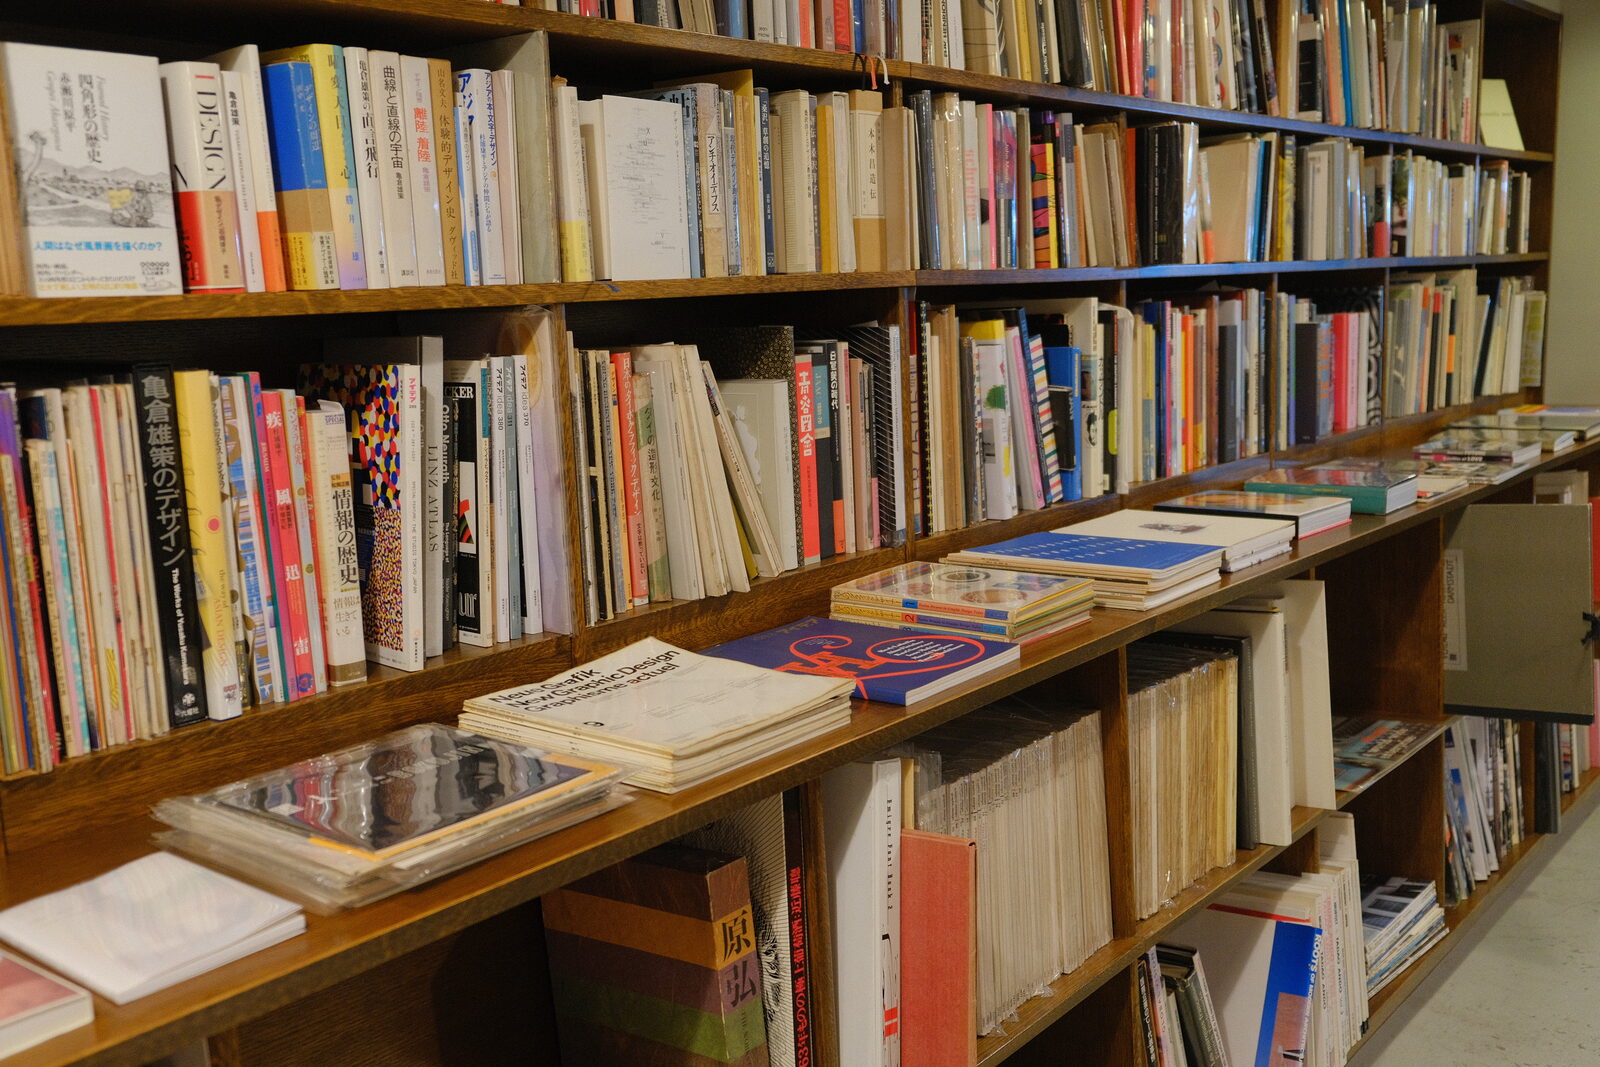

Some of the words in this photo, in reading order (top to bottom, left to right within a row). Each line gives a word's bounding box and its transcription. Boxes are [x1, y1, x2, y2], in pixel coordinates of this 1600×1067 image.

[196, 91, 227, 190] DESIGN
[383, 65, 404, 169] 曲線と直線の宇宙
[440, 114, 456, 219] 体験的デザイン史
[442, 404, 450, 431] Otto
[623, 358, 642, 516] 日本のタイポグラフィック・デザイン
[141, 375, 186, 567] 亀倉雄策のデザイン
[428, 445, 439, 489] LINZ
[442, 434, 450, 484] Neurath
[332, 489, 358, 586] 情報の歴史
[428, 497, 439, 553] ATLAS
[171, 568, 180, 583] The
[173, 584, 181, 606] Works
[176, 618, 187, 643] Yusaku
[180, 645, 190, 686] Kamekura
[506, 692, 554, 709] New
[551, 671, 625, 699] Graphic
[622, 649, 682, 676] Design
[523, 682, 629, 713] Graphisme
[626, 662, 681, 685] actuel
[542, 668, 602, 694] Grafik
[721, 909, 757, 1008] 原弘
[1308, 933, 1322, 973] ROOTS
